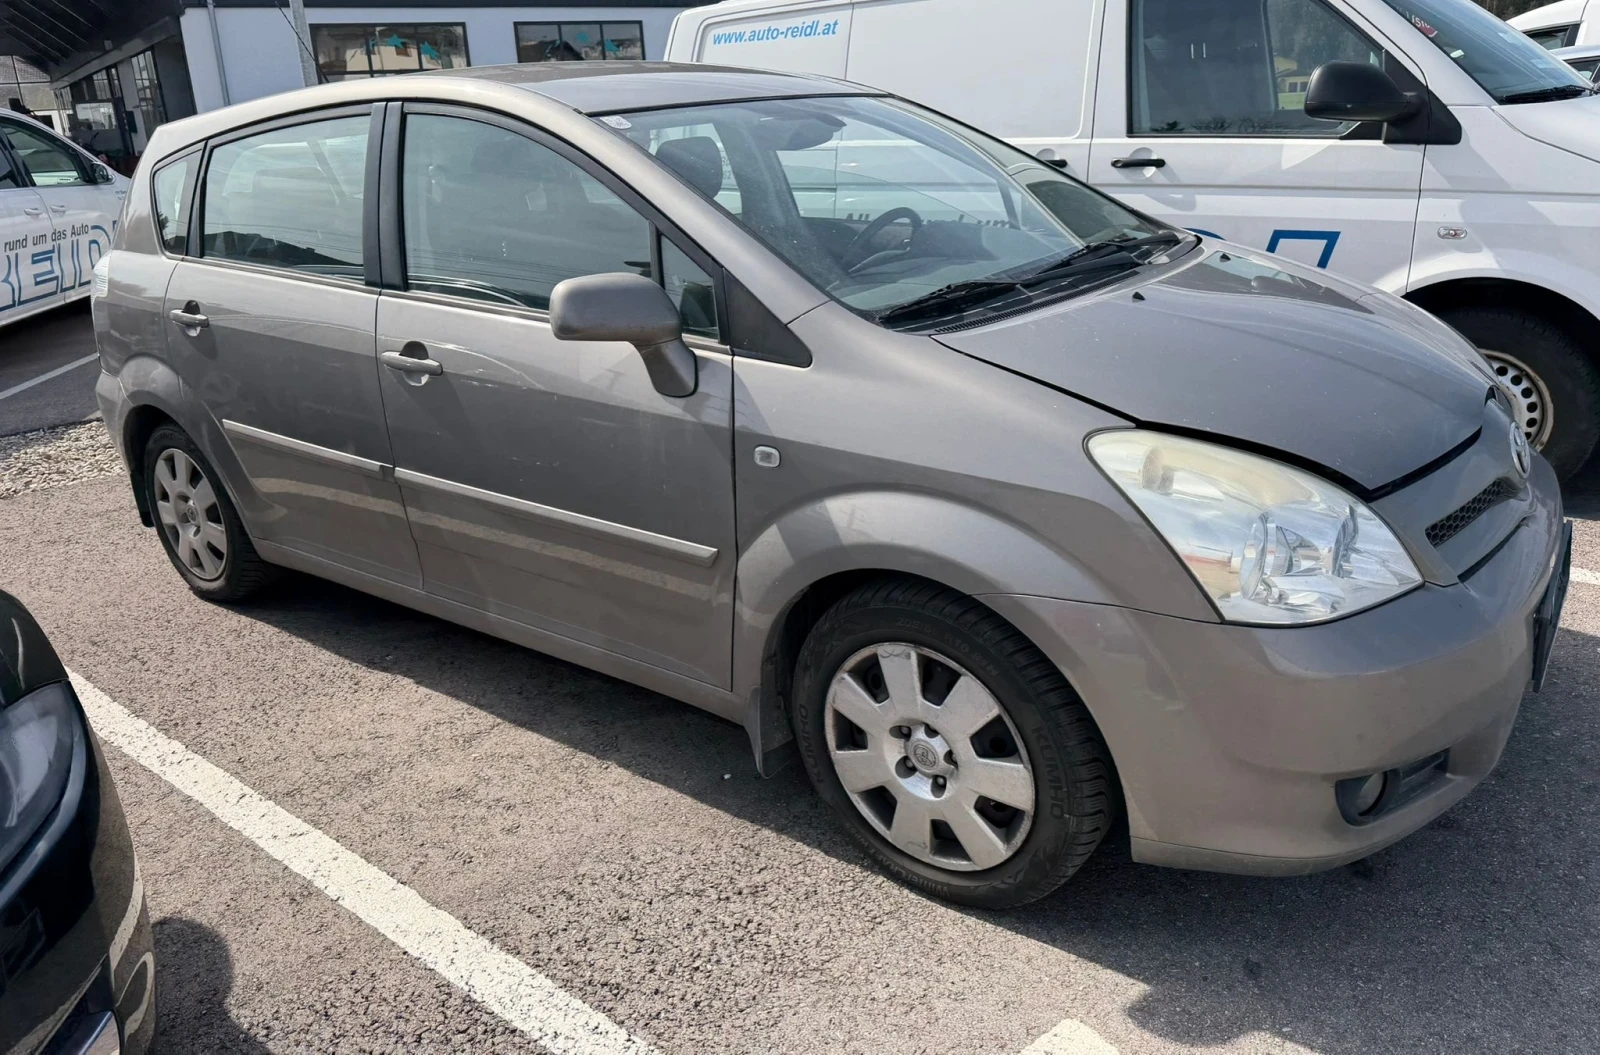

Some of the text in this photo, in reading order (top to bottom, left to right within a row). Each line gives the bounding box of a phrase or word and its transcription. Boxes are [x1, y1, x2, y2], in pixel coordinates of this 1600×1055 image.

[712, 19, 839, 45] www.auto-reidl.at
[4, 223, 89, 252] rund um das Auto
[1031, 726, 1065, 820] KUMHO
